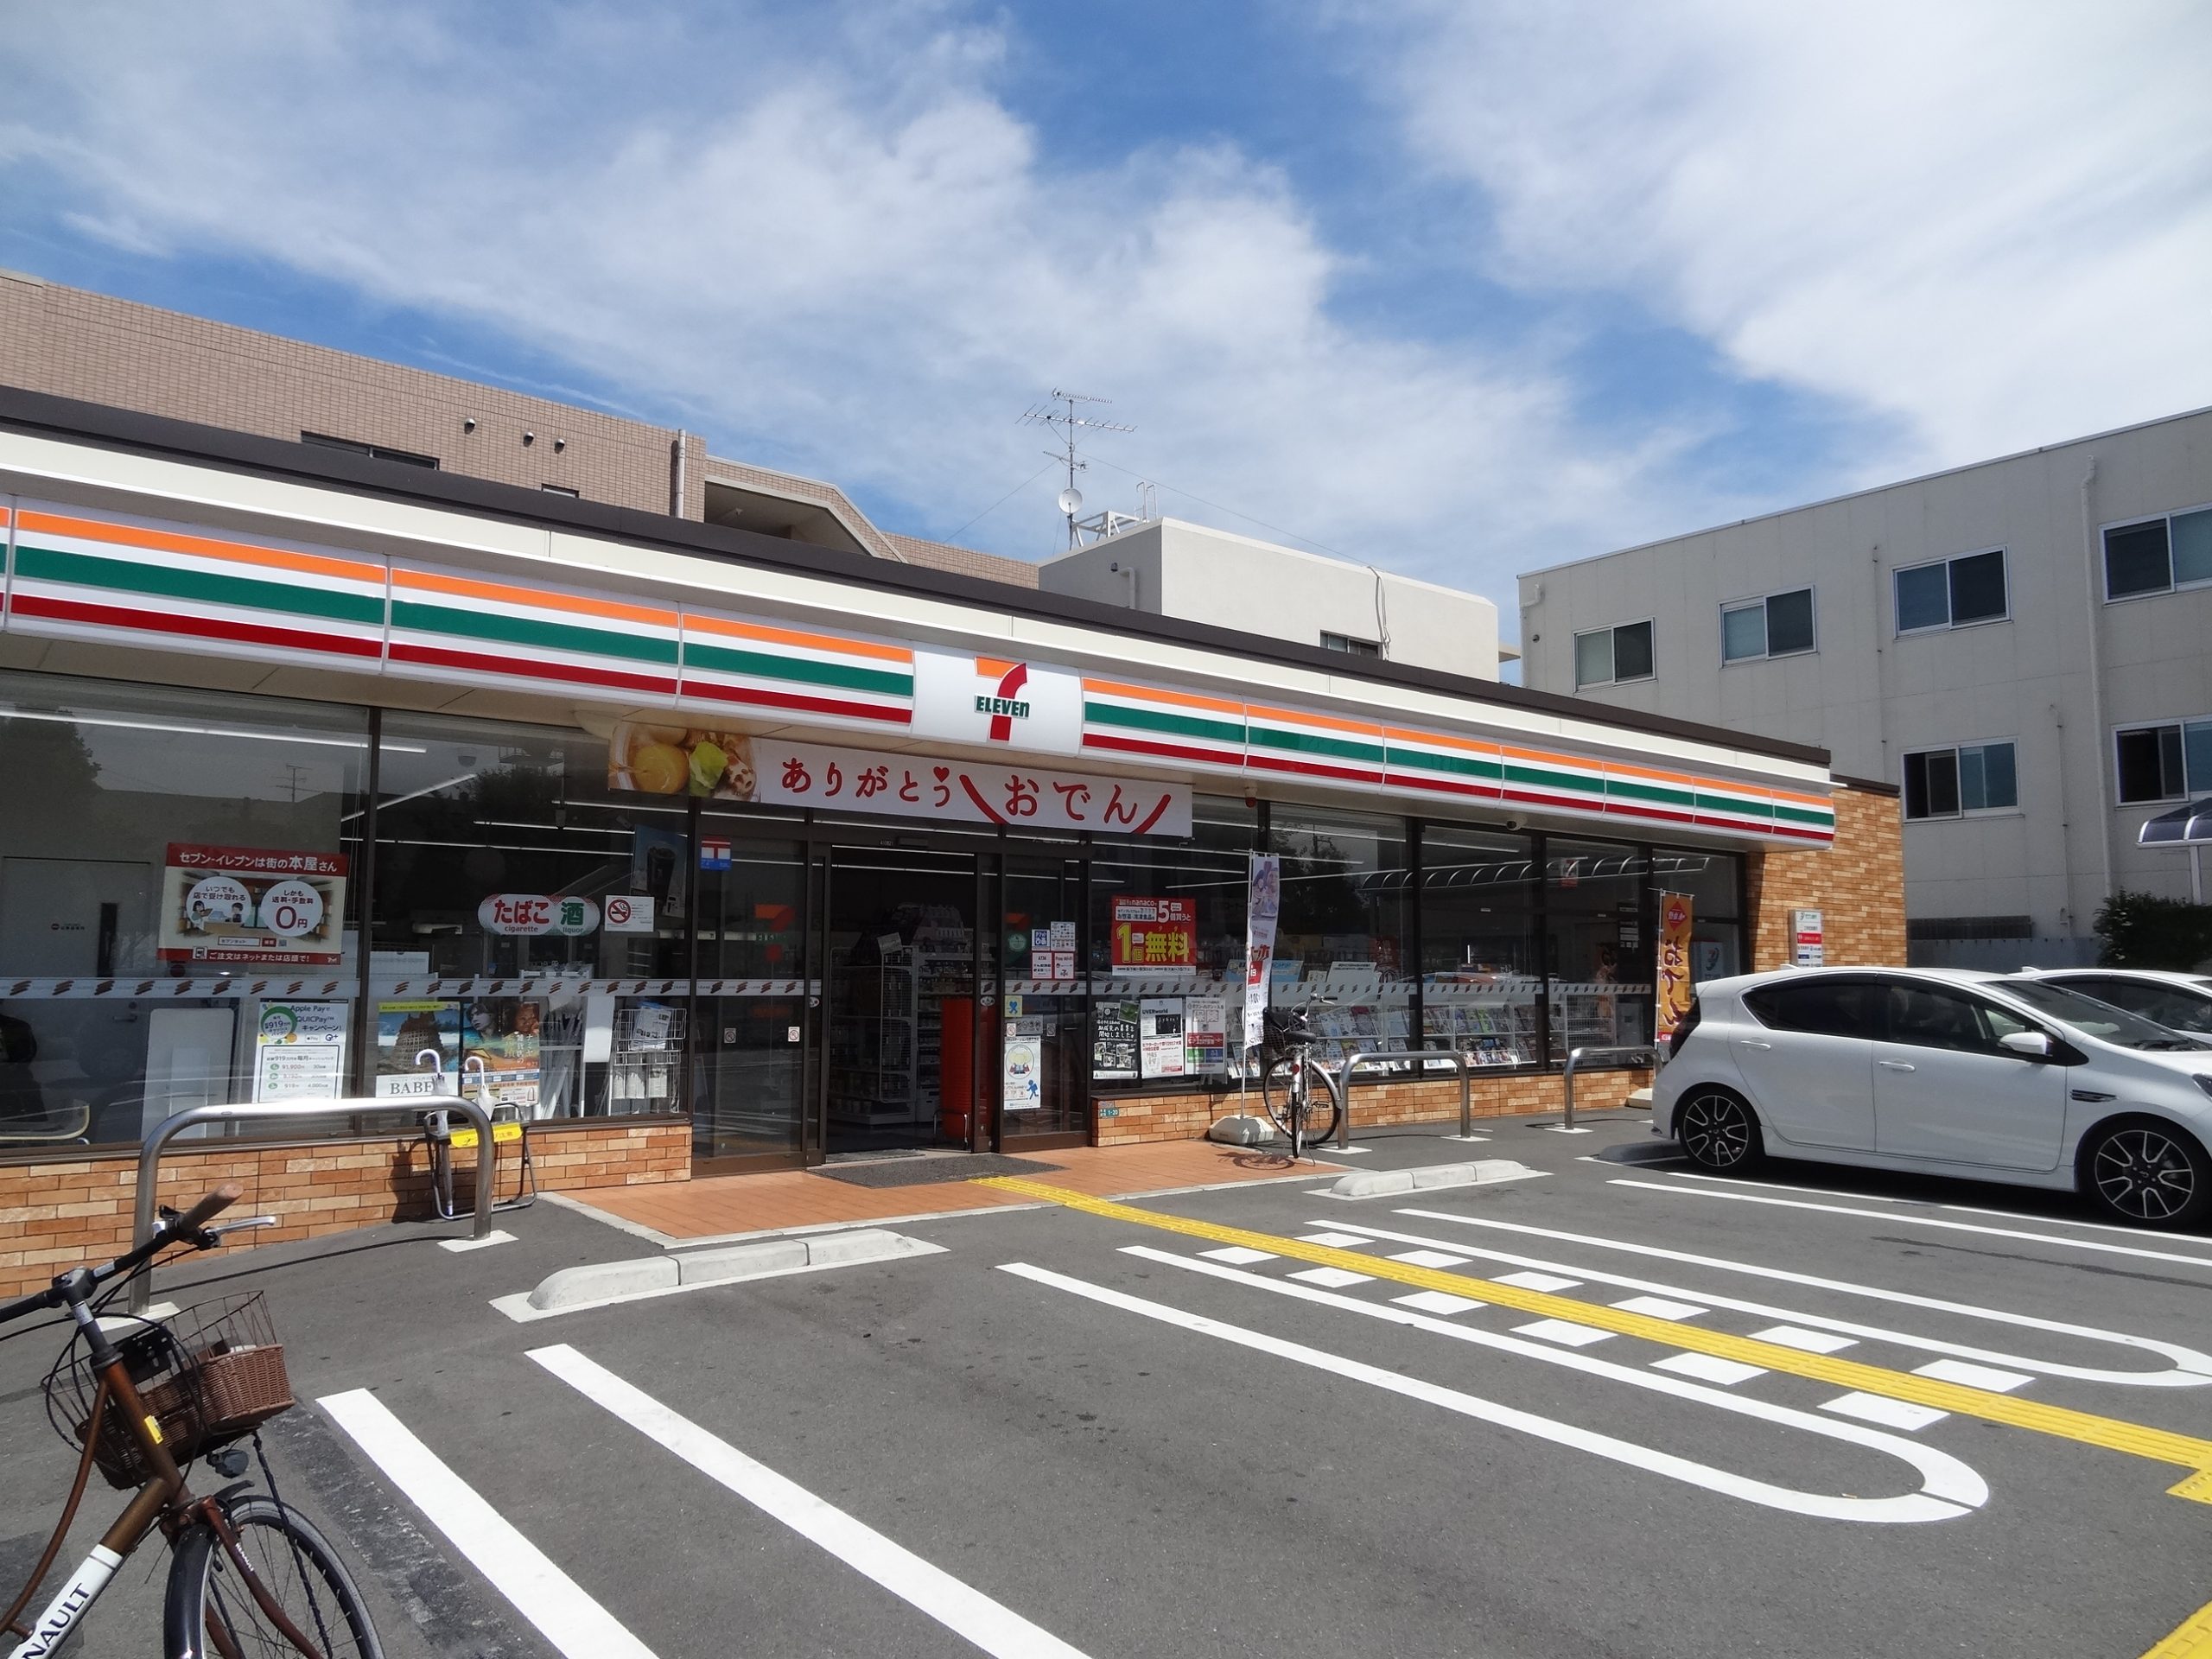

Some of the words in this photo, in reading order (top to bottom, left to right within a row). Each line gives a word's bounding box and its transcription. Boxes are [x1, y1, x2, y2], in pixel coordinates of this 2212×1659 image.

[976, 695, 1030, 718] ELEVEn
[781, 757, 951, 808] ありがとう
[1005, 774, 1137, 824] おでん
[193, 893, 246, 902] 店で受け取れる
[276, 906, 308, 930] 0円
[493, 899, 550, 925] たばこ
[560, 901, 584, 926] 酒
[290, 1005, 311, 1014] Apple
[390, 1081, 434, 1095] BABE
